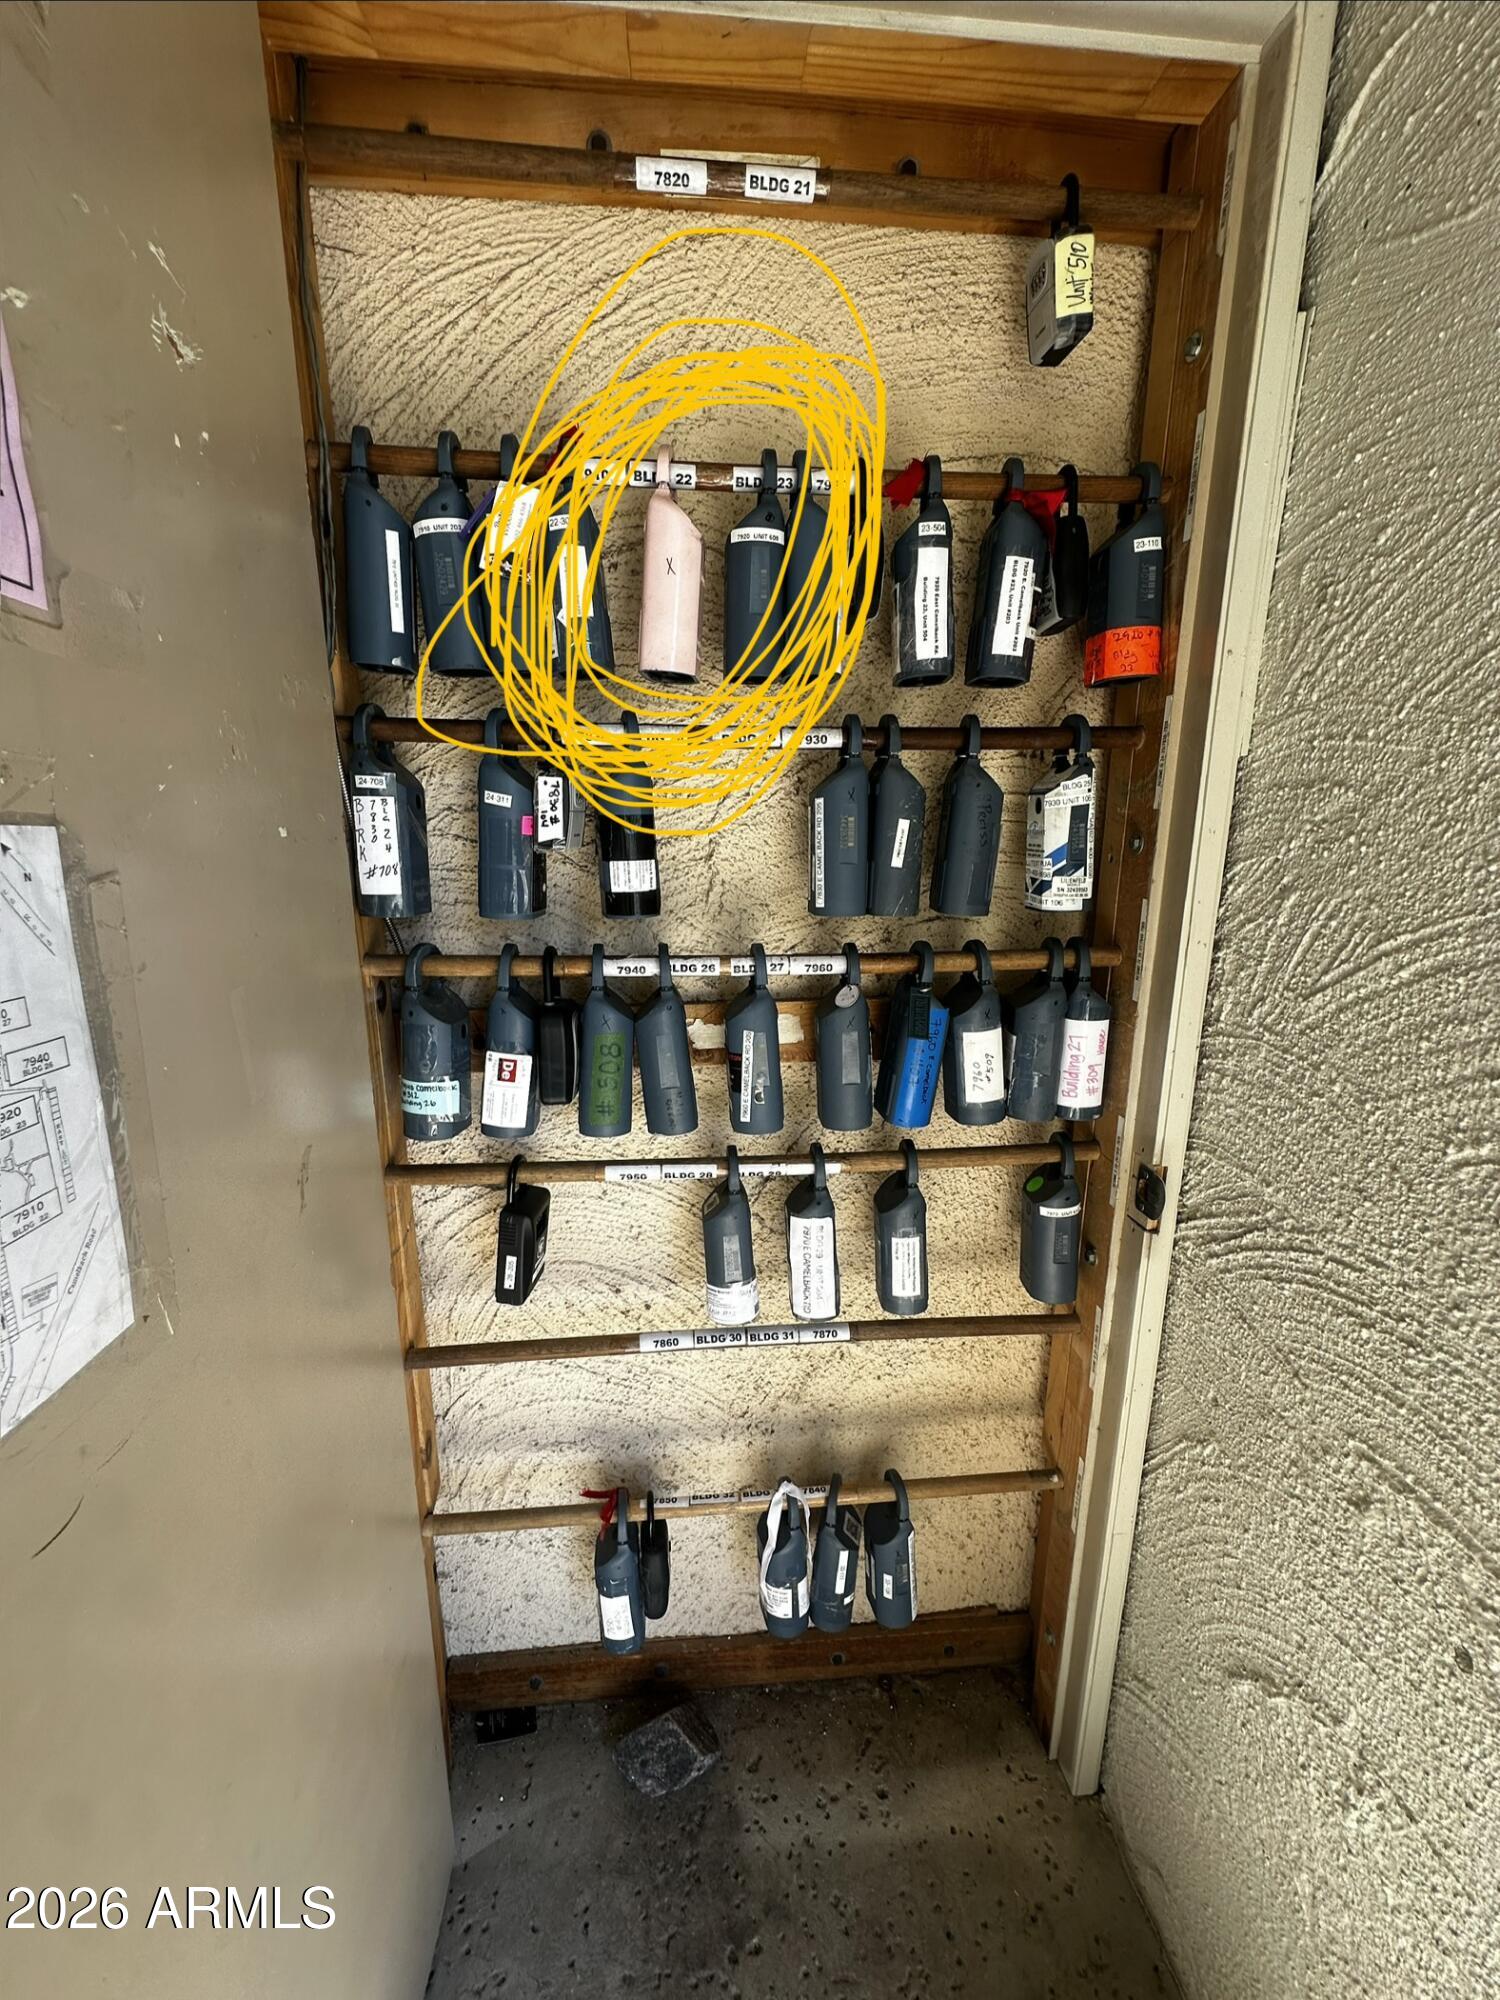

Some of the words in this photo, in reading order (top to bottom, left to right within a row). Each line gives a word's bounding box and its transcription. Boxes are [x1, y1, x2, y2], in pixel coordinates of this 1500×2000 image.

[654, 171, 690, 188] 7820
[749, 174, 789, 193] BLDG
[794, 180, 811, 196] 21
[1067, 241, 1089, 270] 510
[675, 473, 692, 485] 22
[735, 476, 762, 489] BLD
[777, 477, 794, 489] 23
[921, 523, 946, 533] 23-504
[1135, 540, 1159, 548] 23-110
[1017, 585, 1026, 620] Camelback
[804, 734, 828, 745] 930
[1062, 782, 1082, 791] BLDG
[1062, 797, 1080, 805] UNIT
[816, 830, 824, 876] CAMELBACK
[363, 862, 399, 879] #708
[23, 872, 32, 882] N
[616, 965, 646, 975] 7940
[668, 963, 697, 973] LDG
[701, 963, 716, 973] 26
[769, 962, 785, 972] 27
[804, 963, 833, 973] 7960
[23, 1052, 51, 1068] 7940
[22, 1064, 42, 1077] BLDG
[1061, 1054, 1086, 1098] Building
[742, 1056, 750, 1098] CAMELBACK
[1085, 1064, 1102, 1097] #309
[13, 1201, 45, 1224] 7910
[12, 1220, 36, 1239] BLDG
[803, 1252, 811, 1301] CAMELBACK
[696, 1334, 725, 1344] BLDG
[729, 1333, 742, 1342] 30
[749, 1332, 779, 1342] BLDG
[782, 1331, 794, 1340] 31
[813, 1329, 838, 1339] 7870
[653, 1337, 679, 1348] 7860
